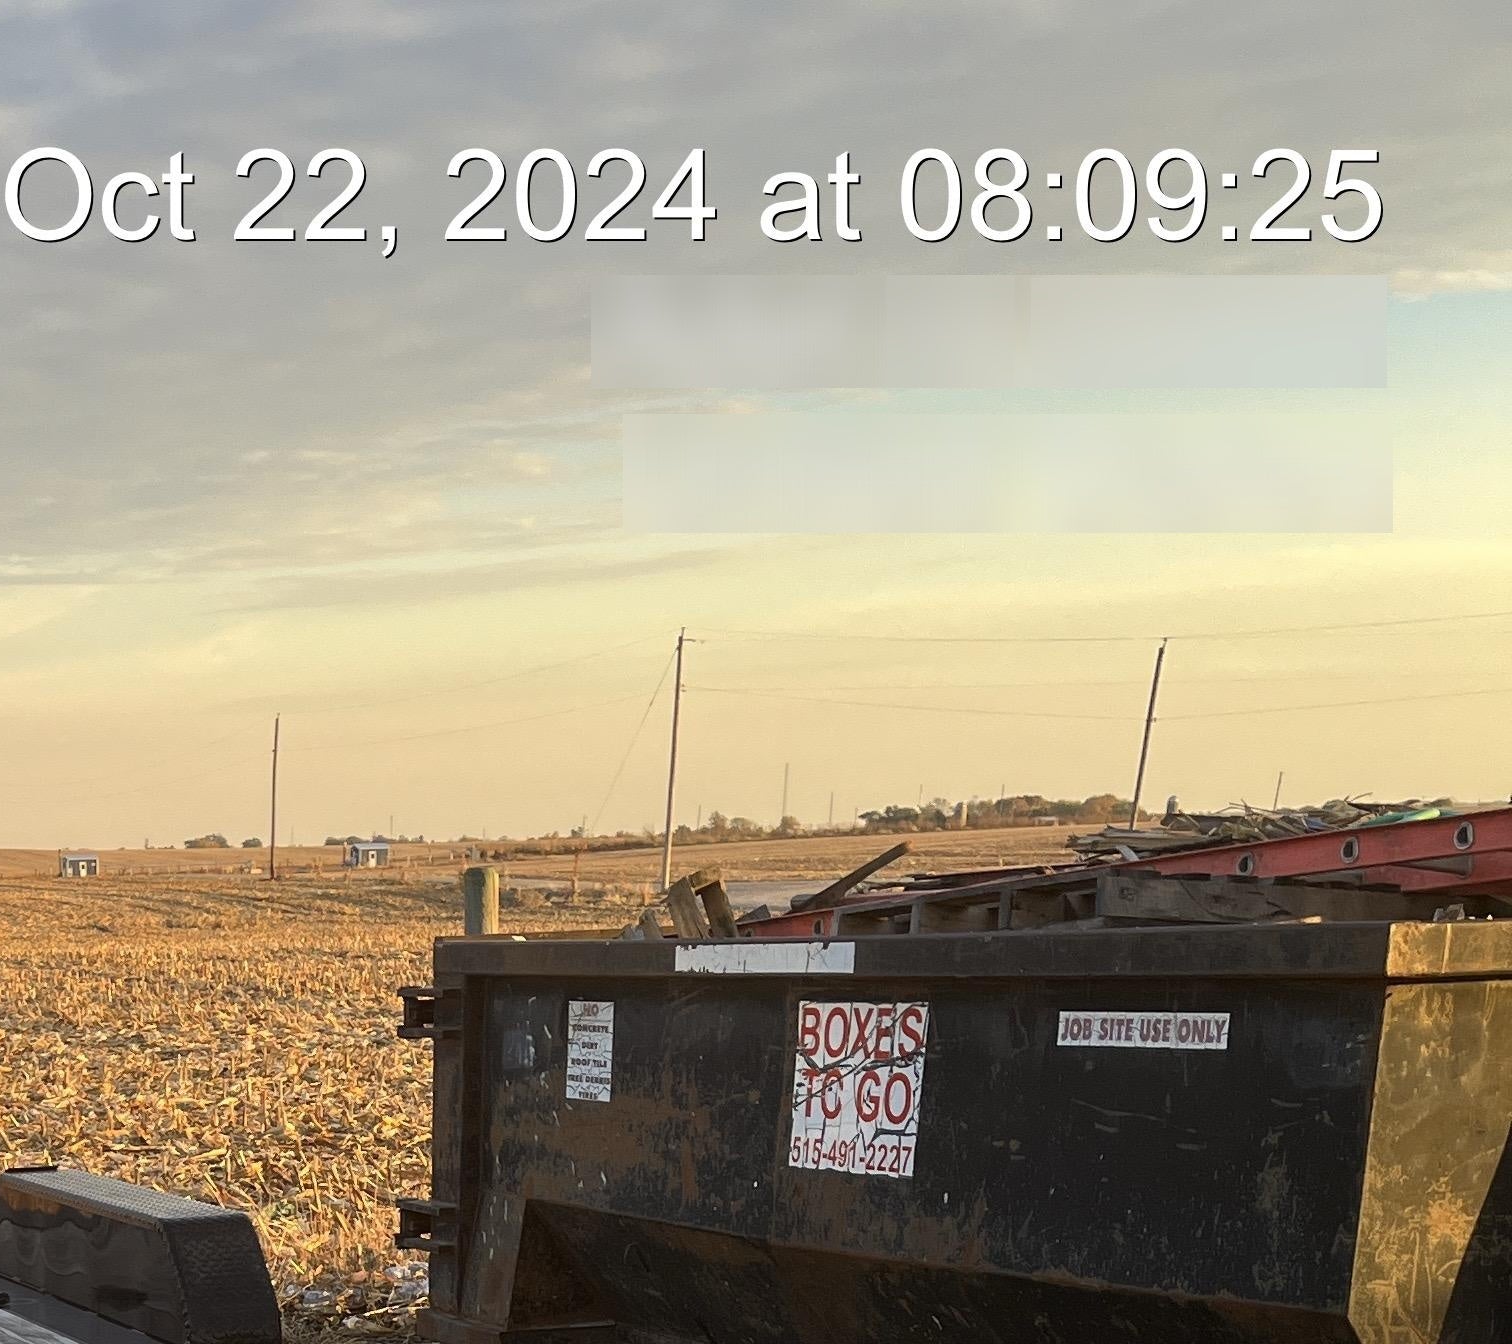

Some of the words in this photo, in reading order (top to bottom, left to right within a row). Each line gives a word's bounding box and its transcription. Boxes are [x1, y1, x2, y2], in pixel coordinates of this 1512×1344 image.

[583, 1003, 599, 1016] NO
[572, 1024, 609, 1034] CONCRETE
[800, 1006, 925, 1061] BOXES
[1061, 1017, 1093, 1042] JOB
[1098, 1018, 1134, 1042] SITE
[1139, 1018, 1172, 1043] USE
[1176, 1018, 1227, 1044] ONLY
[571, 1058, 591, 1067] ROOF
[592, 1059, 608, 1068] TILE
[856, 1069, 912, 1126] GO
[791, 1136, 913, 1174] 515-491-2227
